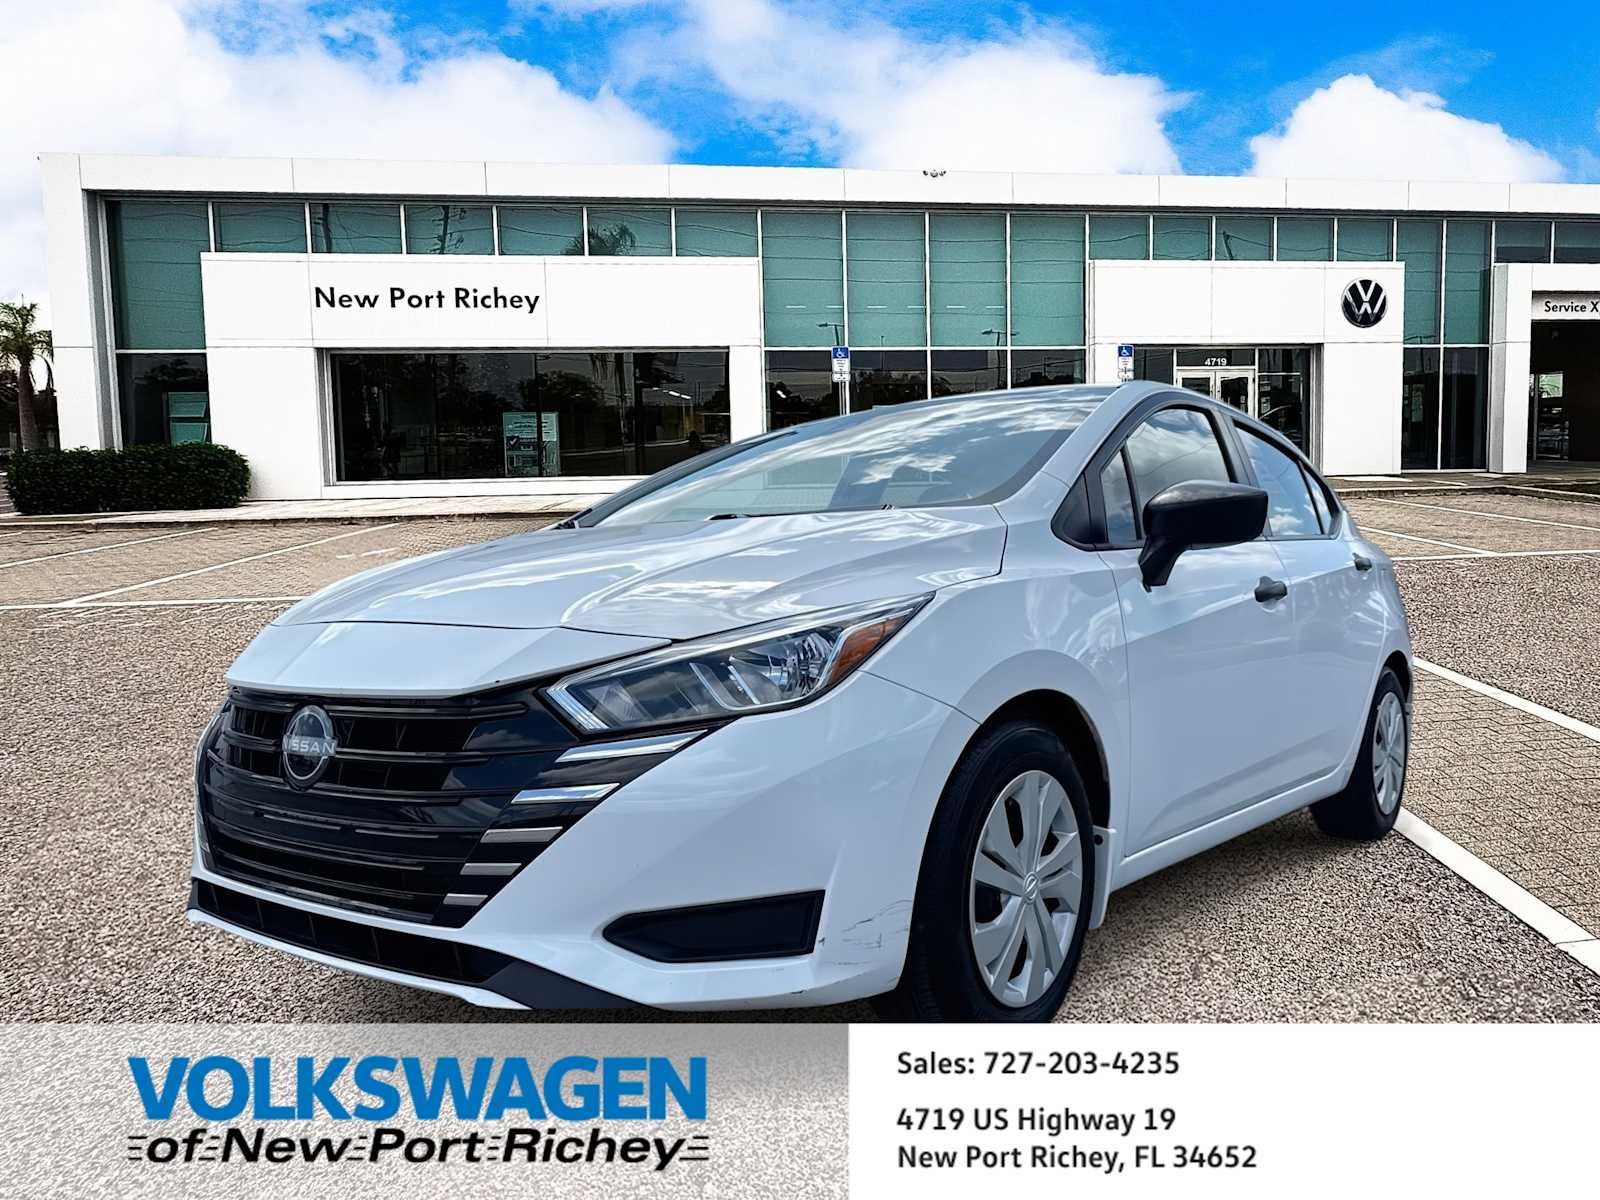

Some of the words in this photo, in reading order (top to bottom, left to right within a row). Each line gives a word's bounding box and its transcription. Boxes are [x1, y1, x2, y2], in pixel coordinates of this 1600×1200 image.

[314, 286, 379, 308] New
[389, 287, 445, 309] Port
[454, 286, 540, 314] Richey
[1544, 300, 1587, 312] Service
[1204, 357, 1227, 366] 4719
[282, 736, 336, 754] NISSAN
